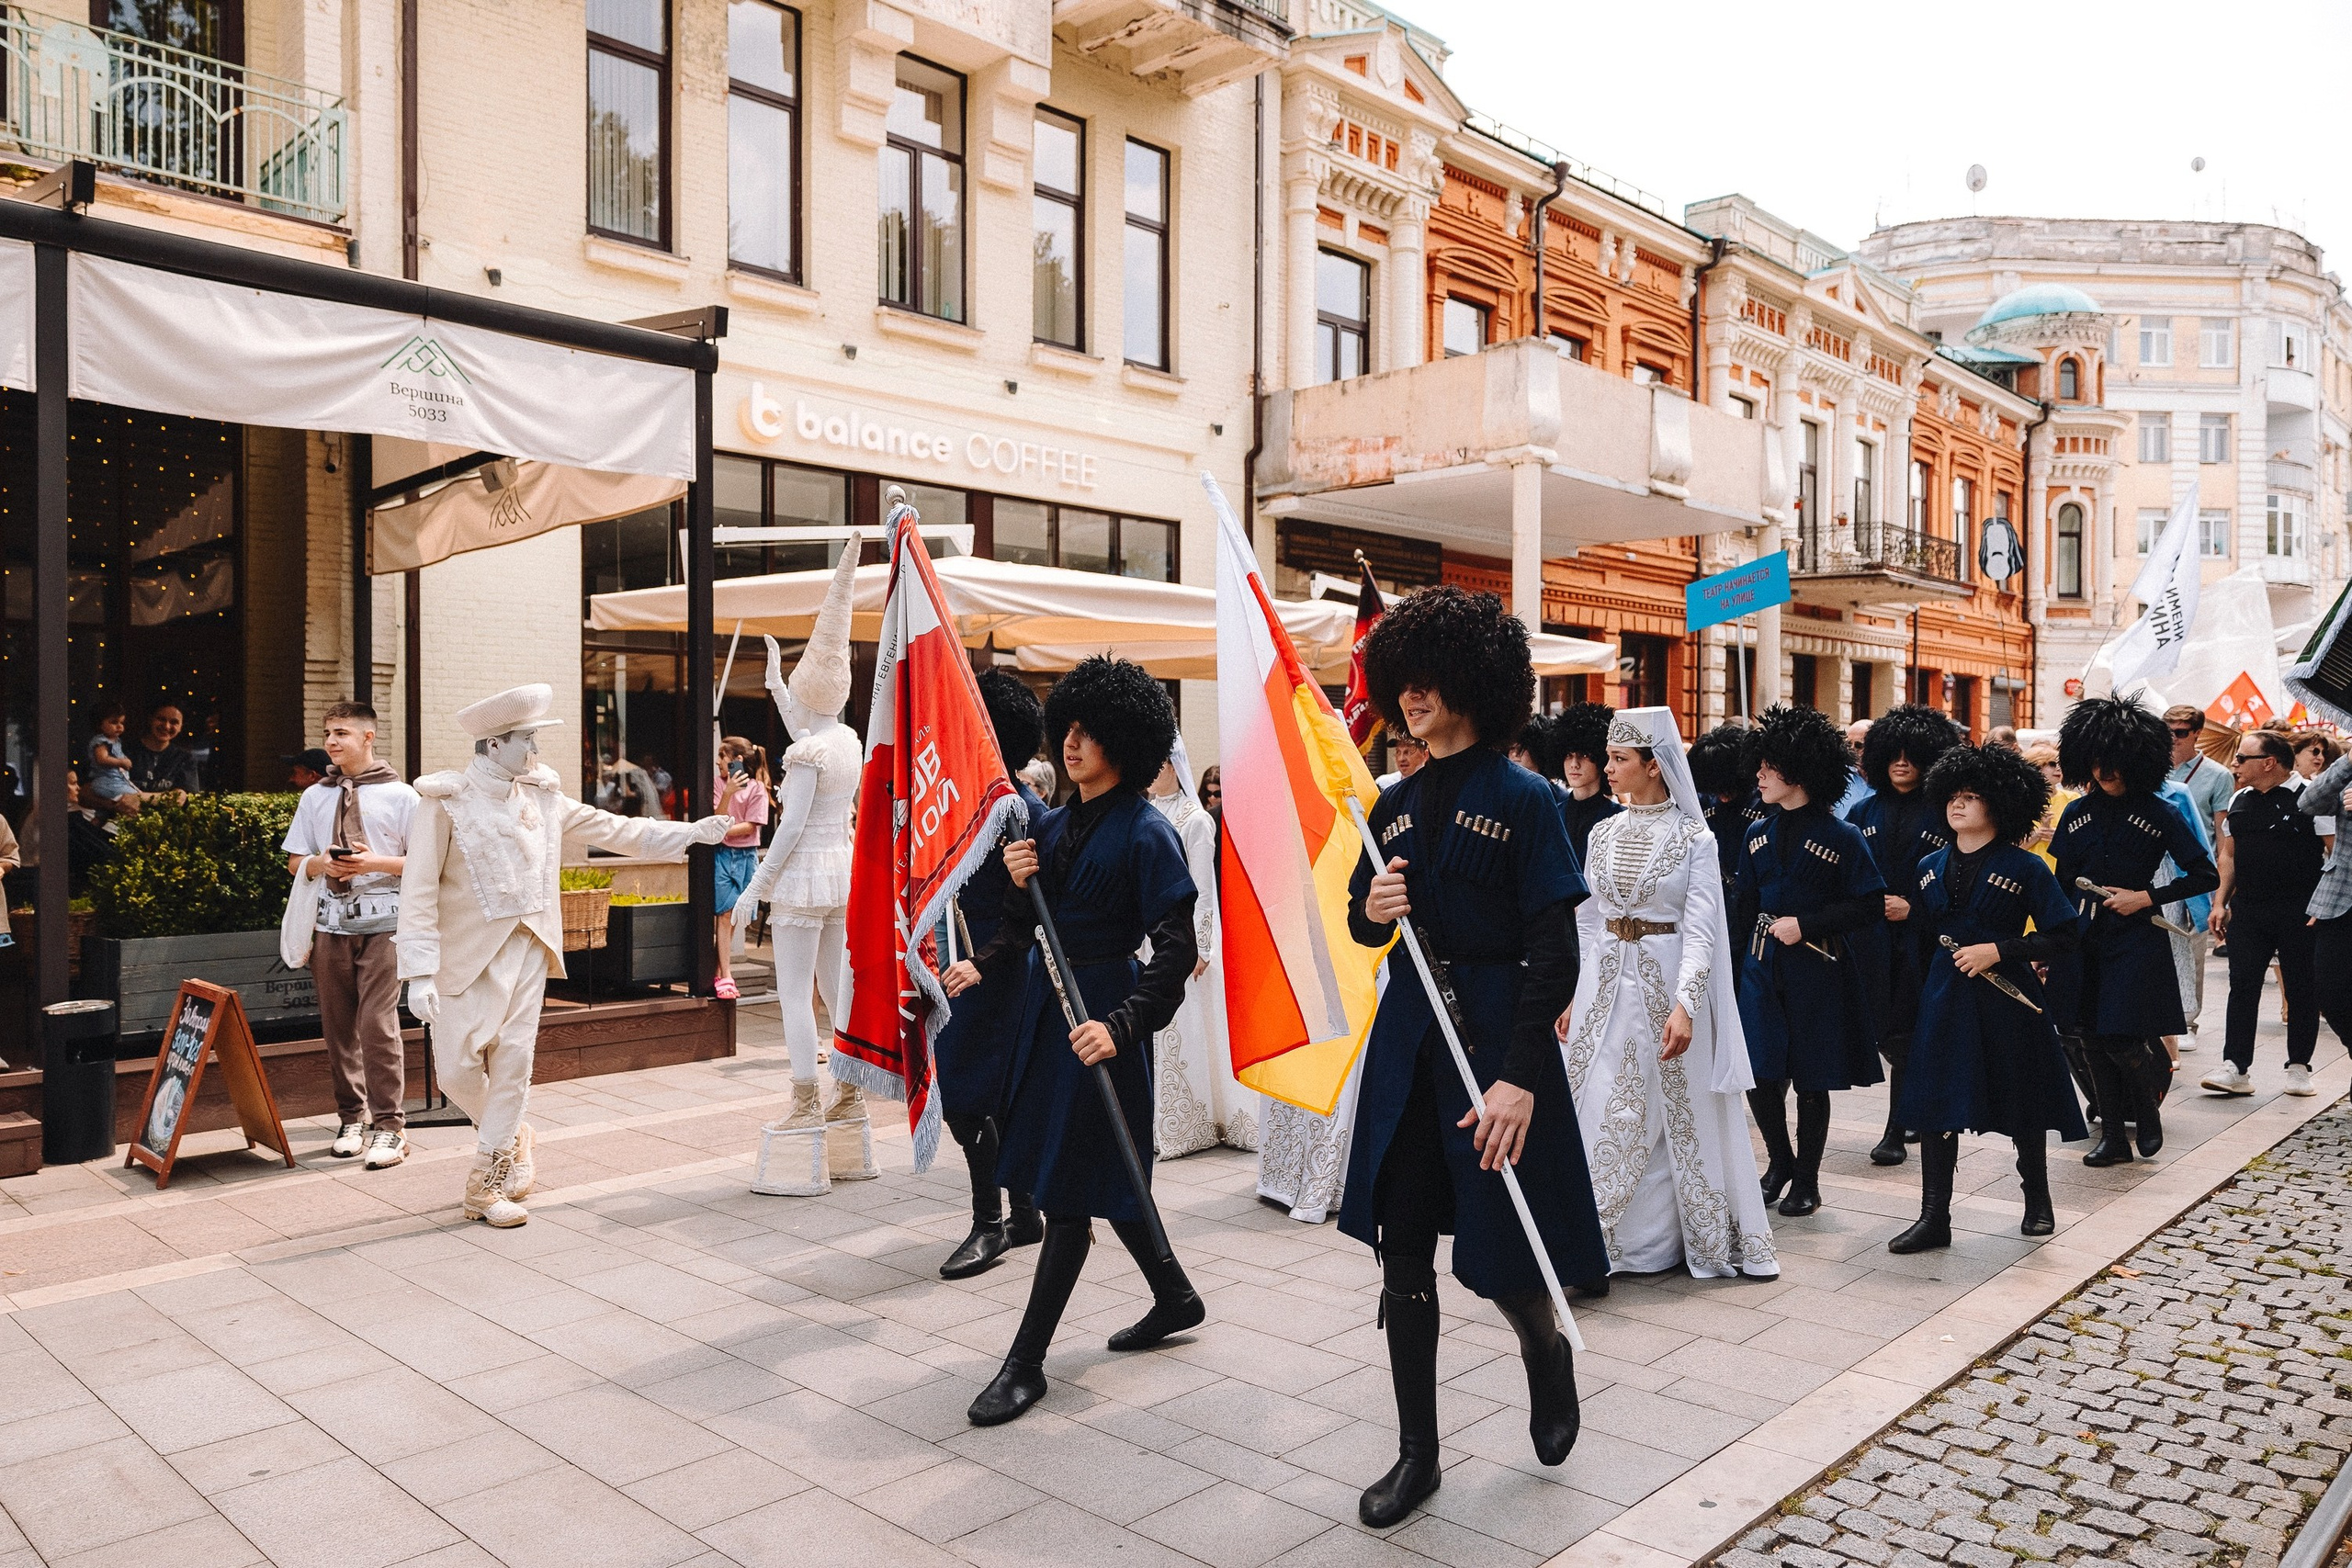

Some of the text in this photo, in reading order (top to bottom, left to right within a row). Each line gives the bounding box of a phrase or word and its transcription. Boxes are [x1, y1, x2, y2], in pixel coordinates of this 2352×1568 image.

[390, 381, 464, 406] Вершина
[408, 404, 447, 423] 5033
[796, 399, 1100, 489] balance COFFEE
[1702, 568, 1770, 600] ТЕАТР НАЧИНАЕТСЯ
[1720, 589, 1756, 610] НА УЛИЦЕ
[2165, 587, 2184, 642] ИМЕНИ
